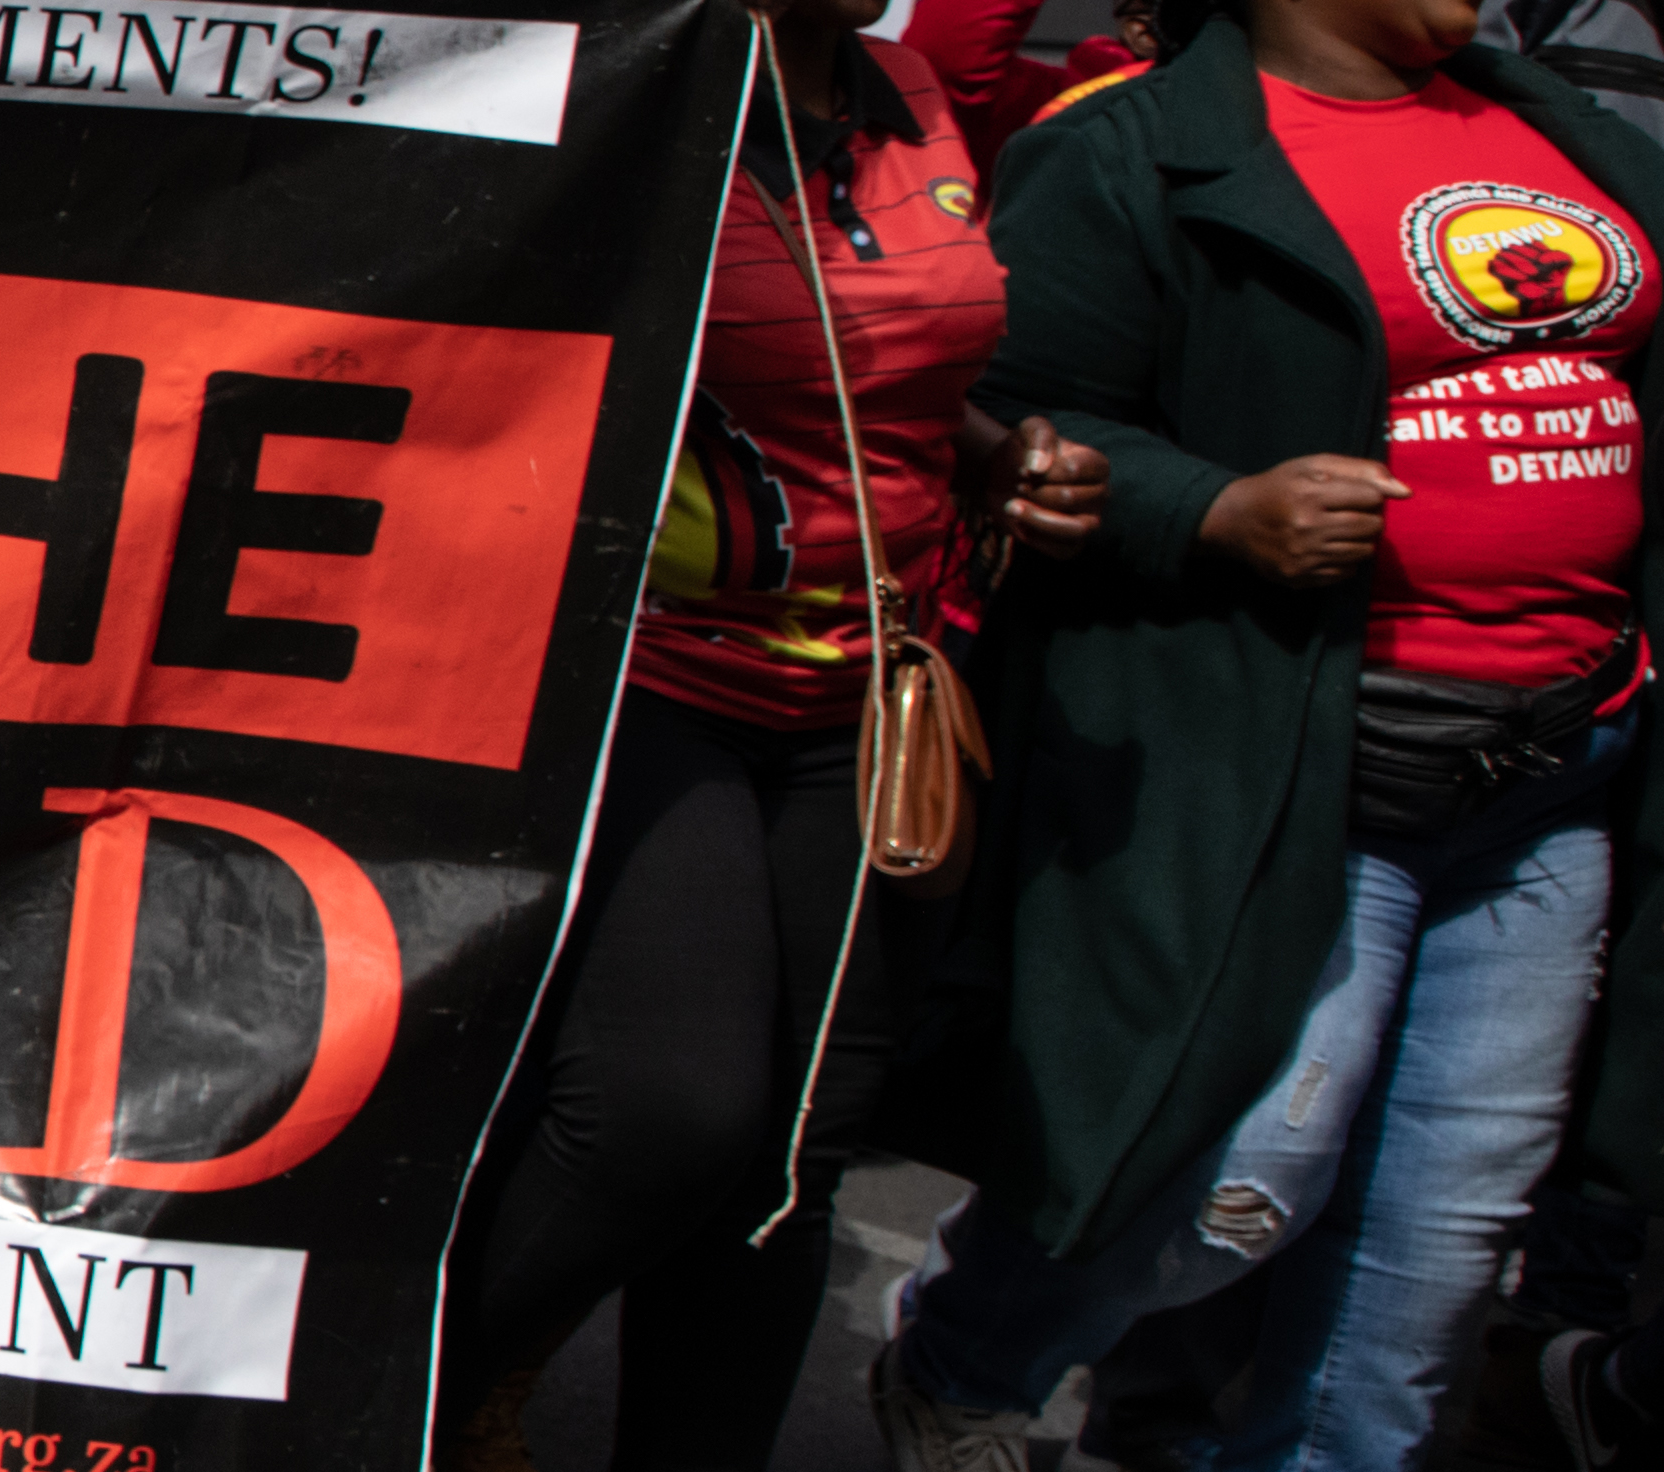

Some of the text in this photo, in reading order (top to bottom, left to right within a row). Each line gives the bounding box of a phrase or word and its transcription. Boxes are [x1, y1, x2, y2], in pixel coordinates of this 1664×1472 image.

[1450, 219, 1564, 255] DETAWU
[1501, 357, 1580, 391] talk
[1479, 411, 1523, 439] to
[1535, 406, 1593, 440] my
[1489, 444, 1631, 485] DETAWU
